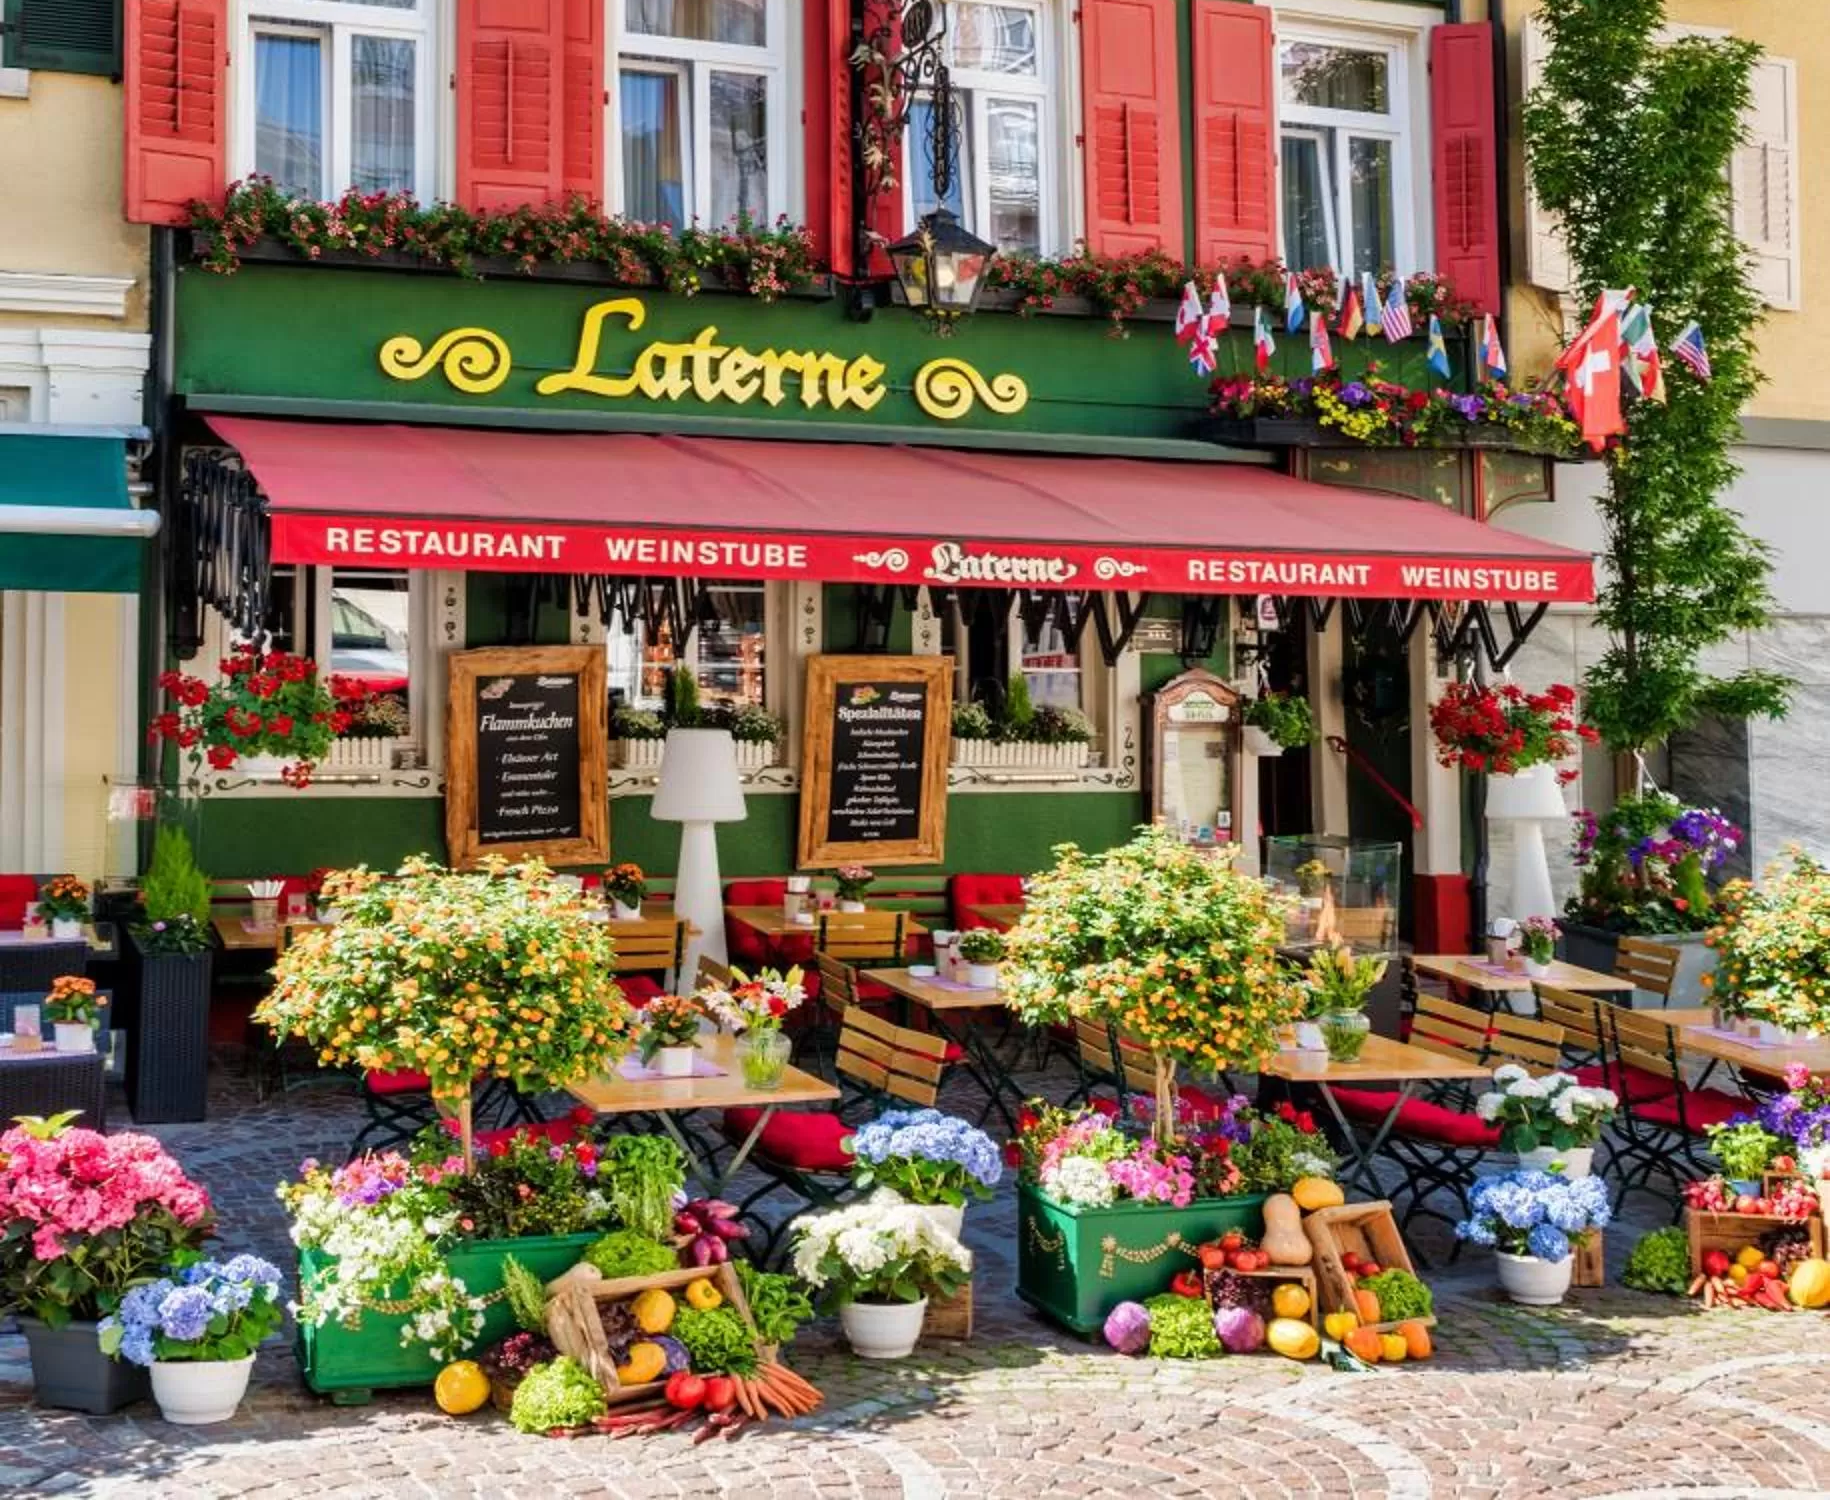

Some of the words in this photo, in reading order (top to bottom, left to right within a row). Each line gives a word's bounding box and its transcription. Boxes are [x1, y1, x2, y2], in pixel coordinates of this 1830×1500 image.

[536, 298, 887, 410] Laterne
[327, 527, 566, 559] RESTAURANT
[605, 537, 808, 568] WEINSTUBE
[923, 542, 1078, 583] Laterne
[1188, 559, 1372, 586] RESTAURANT
[1401, 565, 1558, 592] WEINSTUBE
[480, 711, 573, 732] Flammkuchen
[838, 706, 922, 722] Spezialitäten
